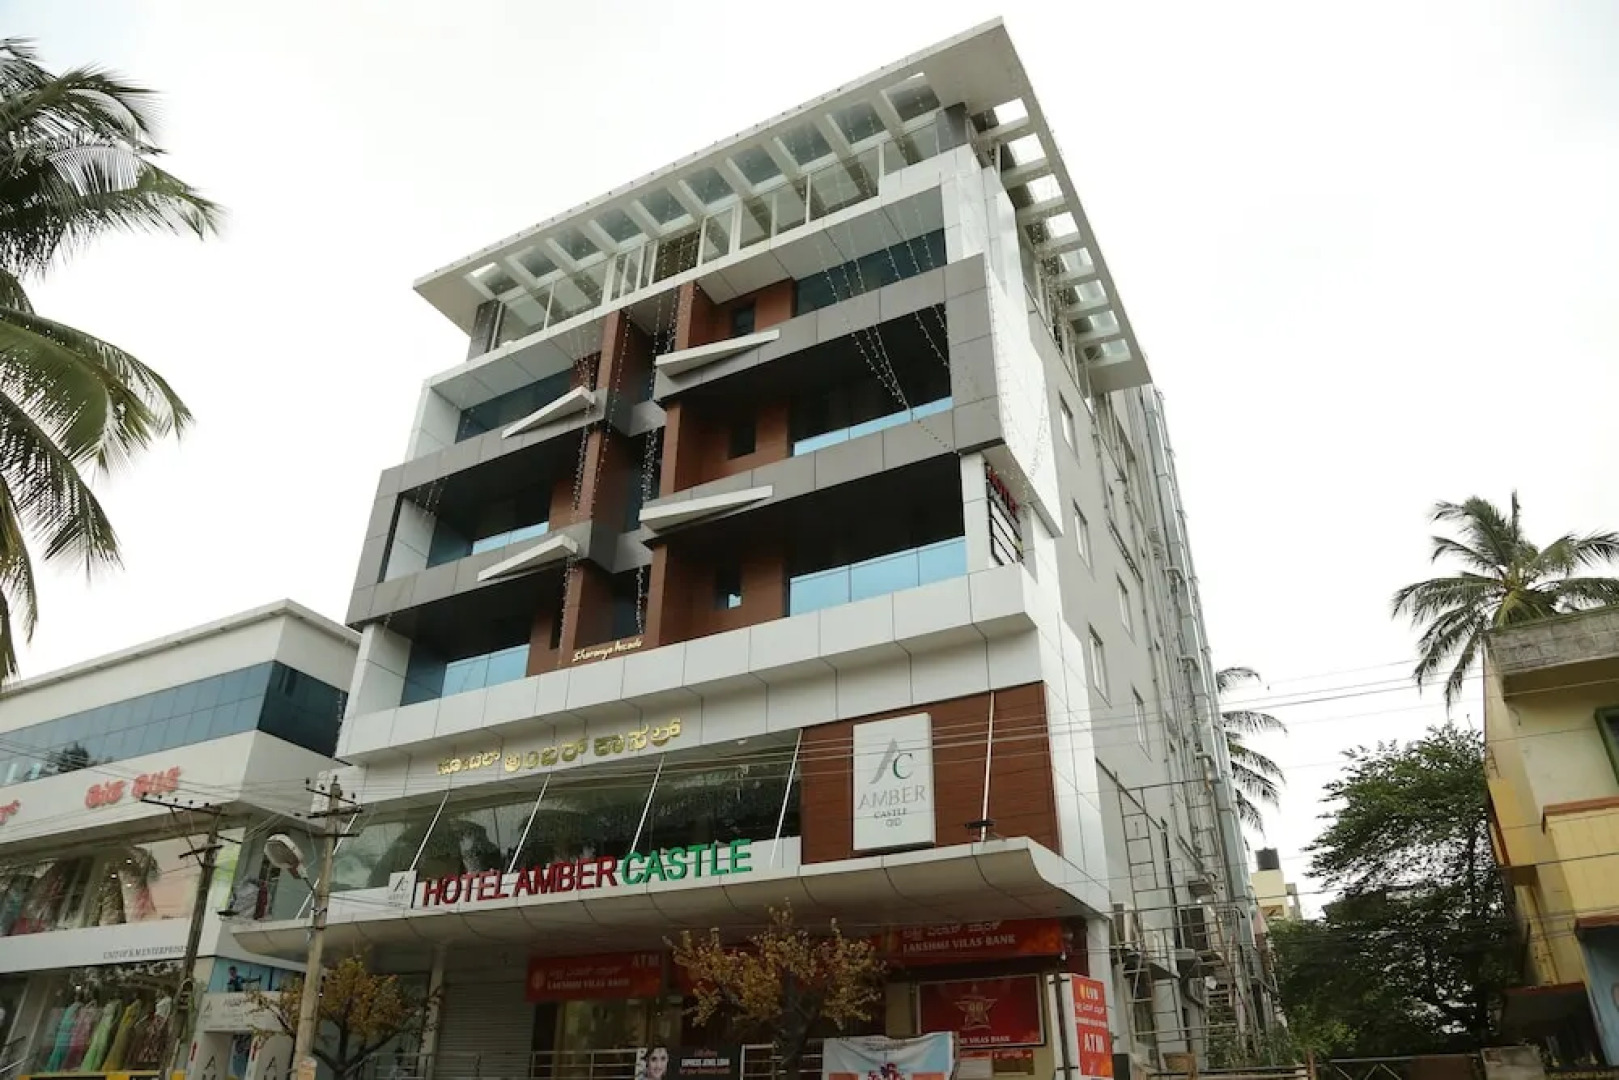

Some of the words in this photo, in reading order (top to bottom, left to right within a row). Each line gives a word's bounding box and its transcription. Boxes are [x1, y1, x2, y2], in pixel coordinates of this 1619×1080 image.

[857, 785, 926, 810] AMBER
[423, 868, 509, 907] HOTEL
[514, 855, 618, 898] AMBER
[622, 838, 752, 885] CASTLE
[952, 937, 982, 949] VILAS
[986, 933, 1016, 946] BANK
[632, 954, 660, 967] ATM
